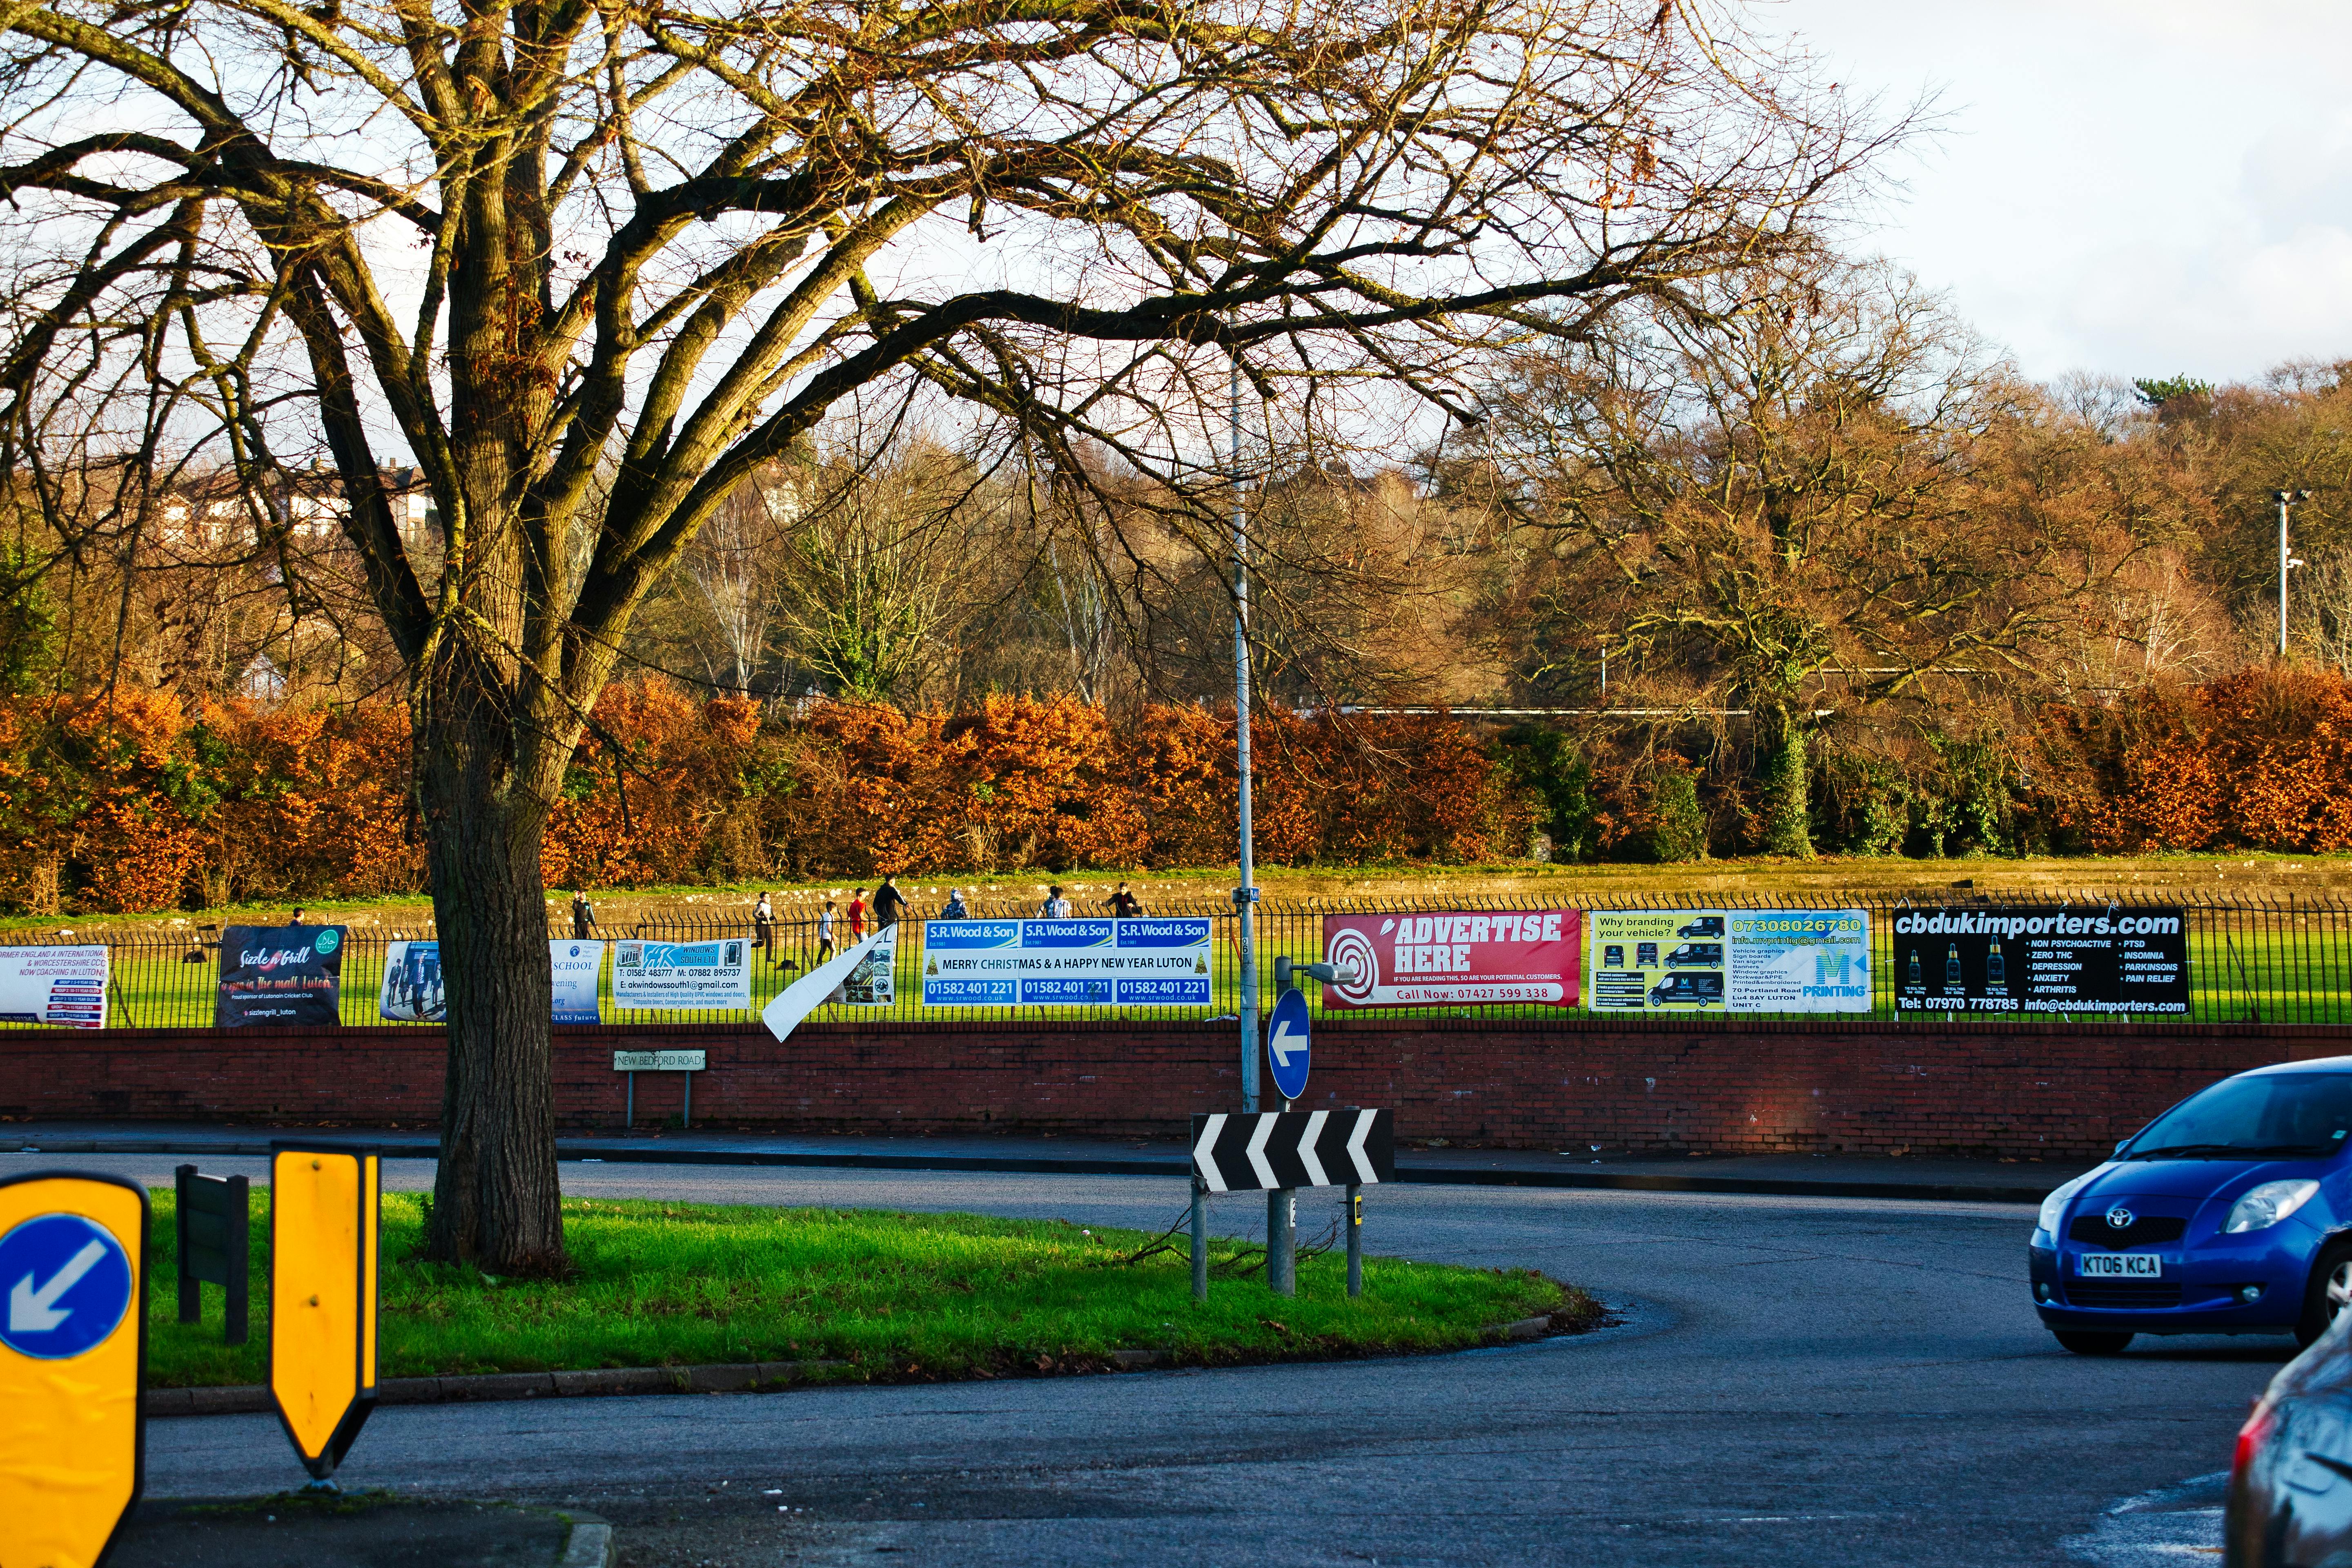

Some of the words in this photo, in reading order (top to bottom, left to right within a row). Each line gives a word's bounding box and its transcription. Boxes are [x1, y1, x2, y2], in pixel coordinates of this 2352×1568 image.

[1600, 918, 1623, 927] Why
[1626, 918, 1674, 927] branding
[1732, 919, 1861, 932] 07308026780
[1896, 912, 2179, 939] cbdukimporters.com
[930, 926, 949, 938] S.R.
[951, 925, 981, 938] Wood
[983, 926, 992, 937] &
[993, 926, 1014, 937] Son
[1026, 925, 1045, 936] S.R.
[1047, 924, 1077, 936] Wood
[1079, 924, 1087, 936] &
[1089, 924, 1109, 935] Son
[1121, 924, 1140, 936] S.R.
[1141, 923, 1172, 936] Wood
[1174, 924, 1183, 935] &
[1185, 924, 1205, 935] Son
[1395, 914, 1562, 944] ADVERTISE
[1599, 930, 1623, 938] your
[1627, 929, 1670, 937] vehicle?
[1732, 936, 1860, 946] info.mvprintig@gmail.com
[240, 948, 270, 968] Sizzle
[281, 947, 310, 966] Grill
[943, 959, 978, 969] MERRY
[981, 959, 1041, 969] CHRISTMAS
[1044, 959, 1051, 969] &
[1054, 959, 1061, 969] A
[1064, 958, 1099, 968] HAPPY
[1102, 958, 1125, 968] NEW
[1127, 958, 1154, 968] YEAR
[1157, 958, 1192, 968] LUTON
[1394, 944, 1470, 973] HERE
[554, 962, 593, 970] SCHOOL
[79, 969, 105, 977] LUTON!
[628, 980, 738, 991] akwindowssouth1@gmail.com
[928, 982, 964, 994] 01582
[967, 982, 987, 993] 401
[991, 982, 1012, 993] 221
[1025, 982, 1061, 993] 01582
[1063, 982, 1083, 993] 401
[1087, 982, 1108, 993] 221
[1120, 982, 1157, 993] 01582
[1160, 982, 1180, 993] 401
[1184, 982, 1205, 993] 221
[1803, 985, 1865, 997] PRINTING
[1397, 989, 1419, 999] Call
[1424, 989, 1454, 999] Now:
[1458, 989, 1494, 998] 07427
[1499, 989, 1521, 998] 599
[1526, 988, 1548, 998] 338
[1898, 998, 1921, 1009] Tel:
[1925, 998, 1964, 1009] 07970
[1969, 998, 2018, 1010] 778785
[2025, 999, 2185, 1013] info@cbdukimporters.com
[618, 1056, 637, 1065] NEW
[639, 1056, 675, 1065] BEDFORD
[678, 1056, 701, 1065] ROAD
[2083, 1256, 2122, 1273] KT06
[2126, 1256, 2156, 1274] KCA
